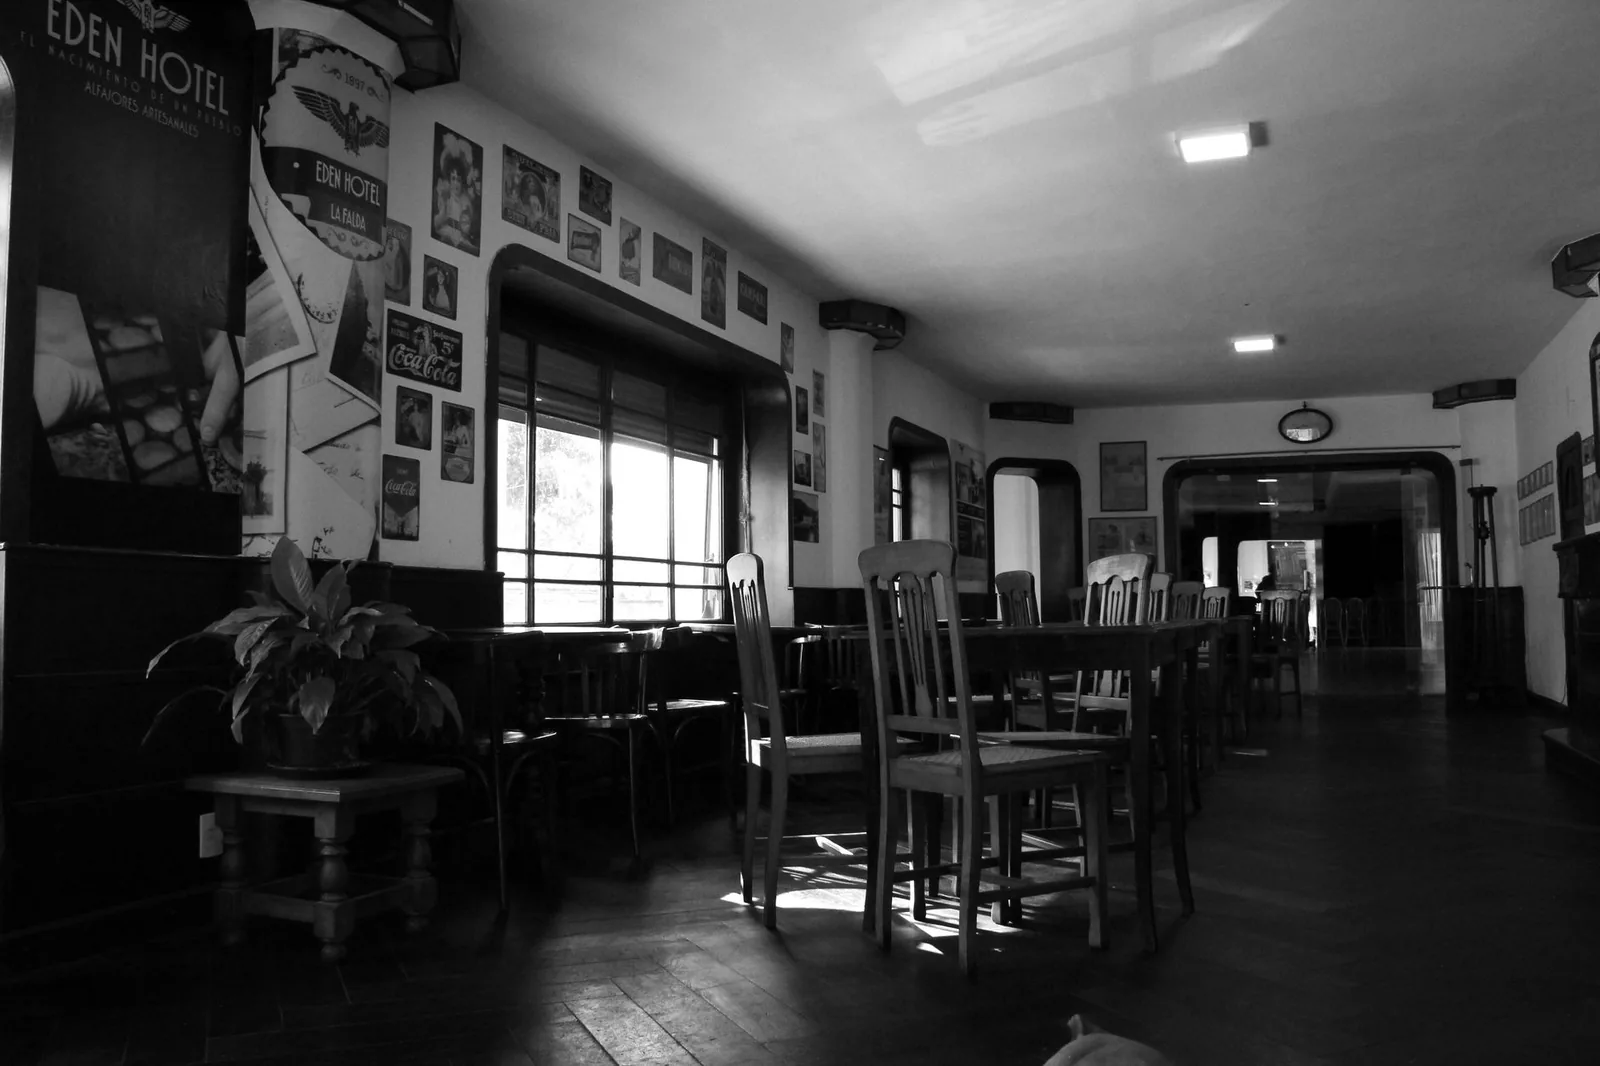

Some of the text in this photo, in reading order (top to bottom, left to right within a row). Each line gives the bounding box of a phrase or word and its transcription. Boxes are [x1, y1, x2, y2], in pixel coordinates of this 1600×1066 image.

[47, 0, 229, 115] EDEN HOTEL
[48, 45, 140, 93] NACIMIENTO
[84, 81, 199, 138] ALFAJORES ARTESANALES
[315, 160, 381, 207] EDEN HOTEL
[330, 203, 367, 232] LA FALDA
